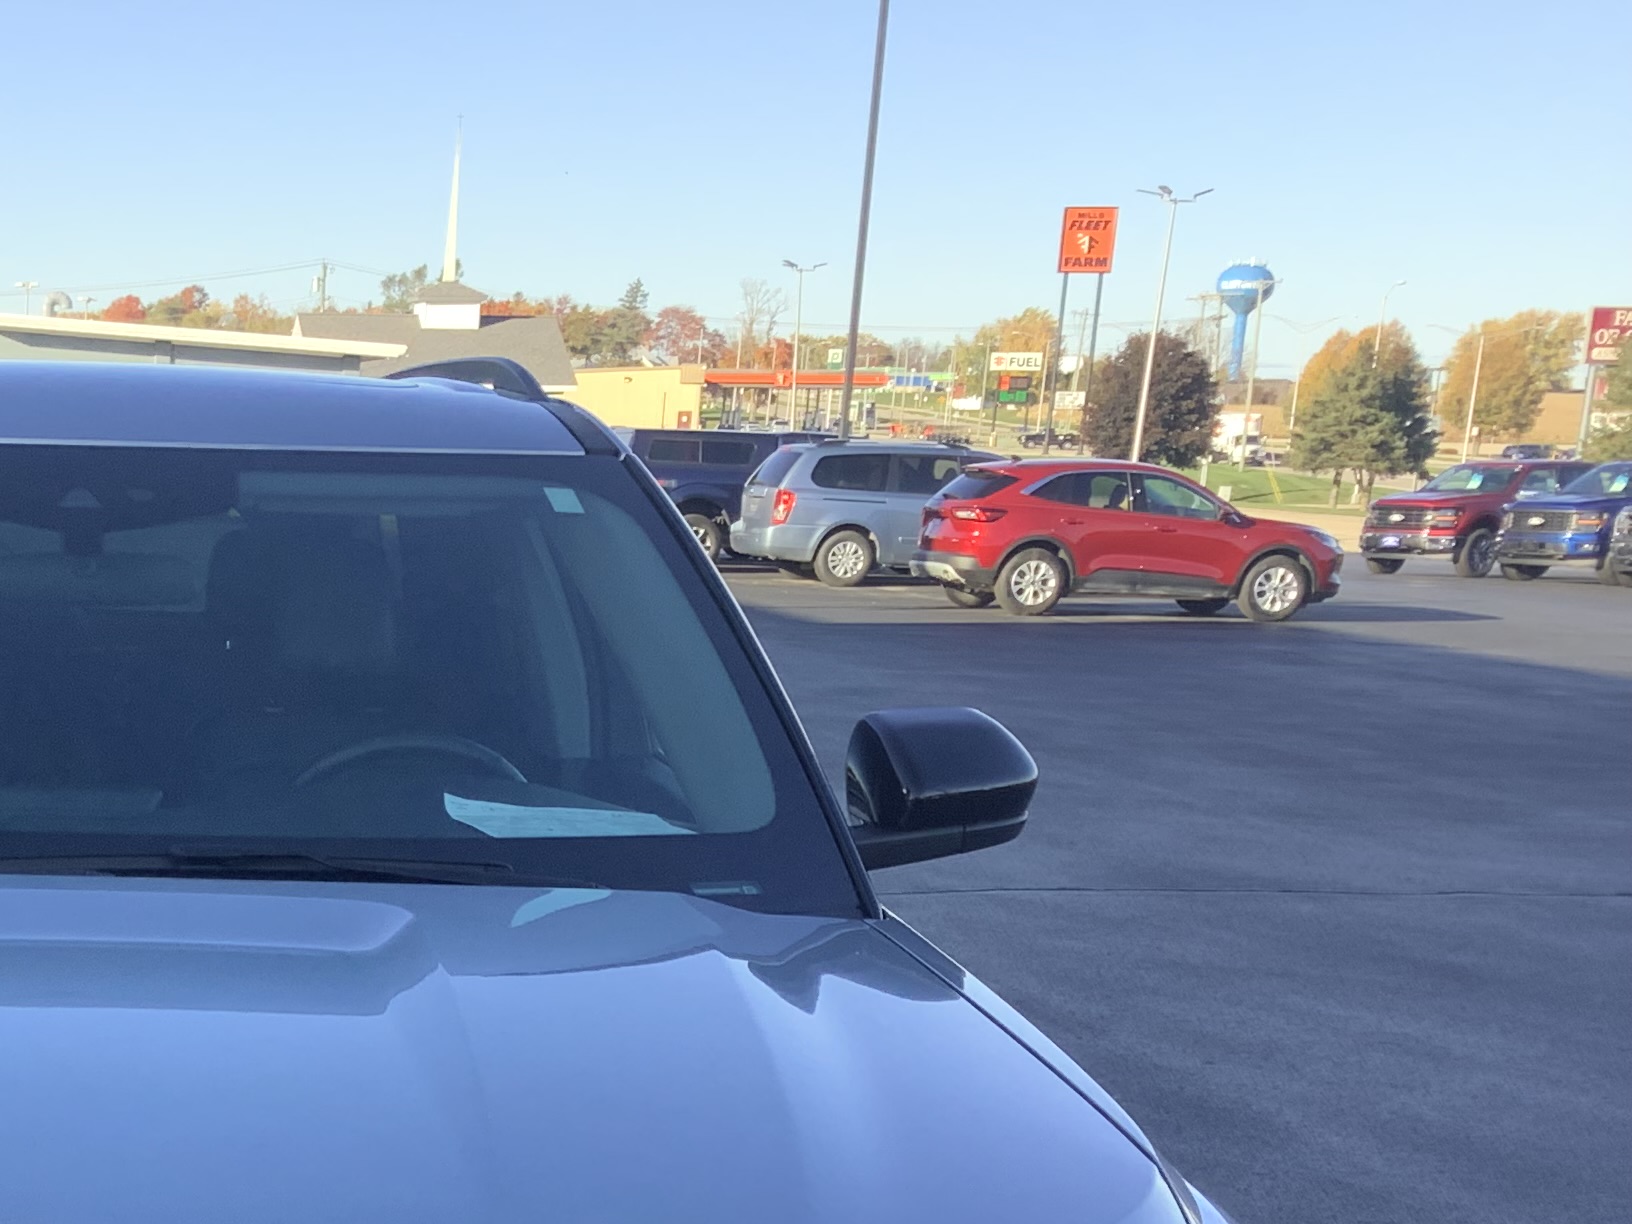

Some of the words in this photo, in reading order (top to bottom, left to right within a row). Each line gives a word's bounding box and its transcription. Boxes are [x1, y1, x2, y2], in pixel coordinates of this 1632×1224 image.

[1068, 220, 1112, 231] FLEET
[1064, 256, 1108, 267] FARM
[1009, 357, 1041, 367] FUEL
